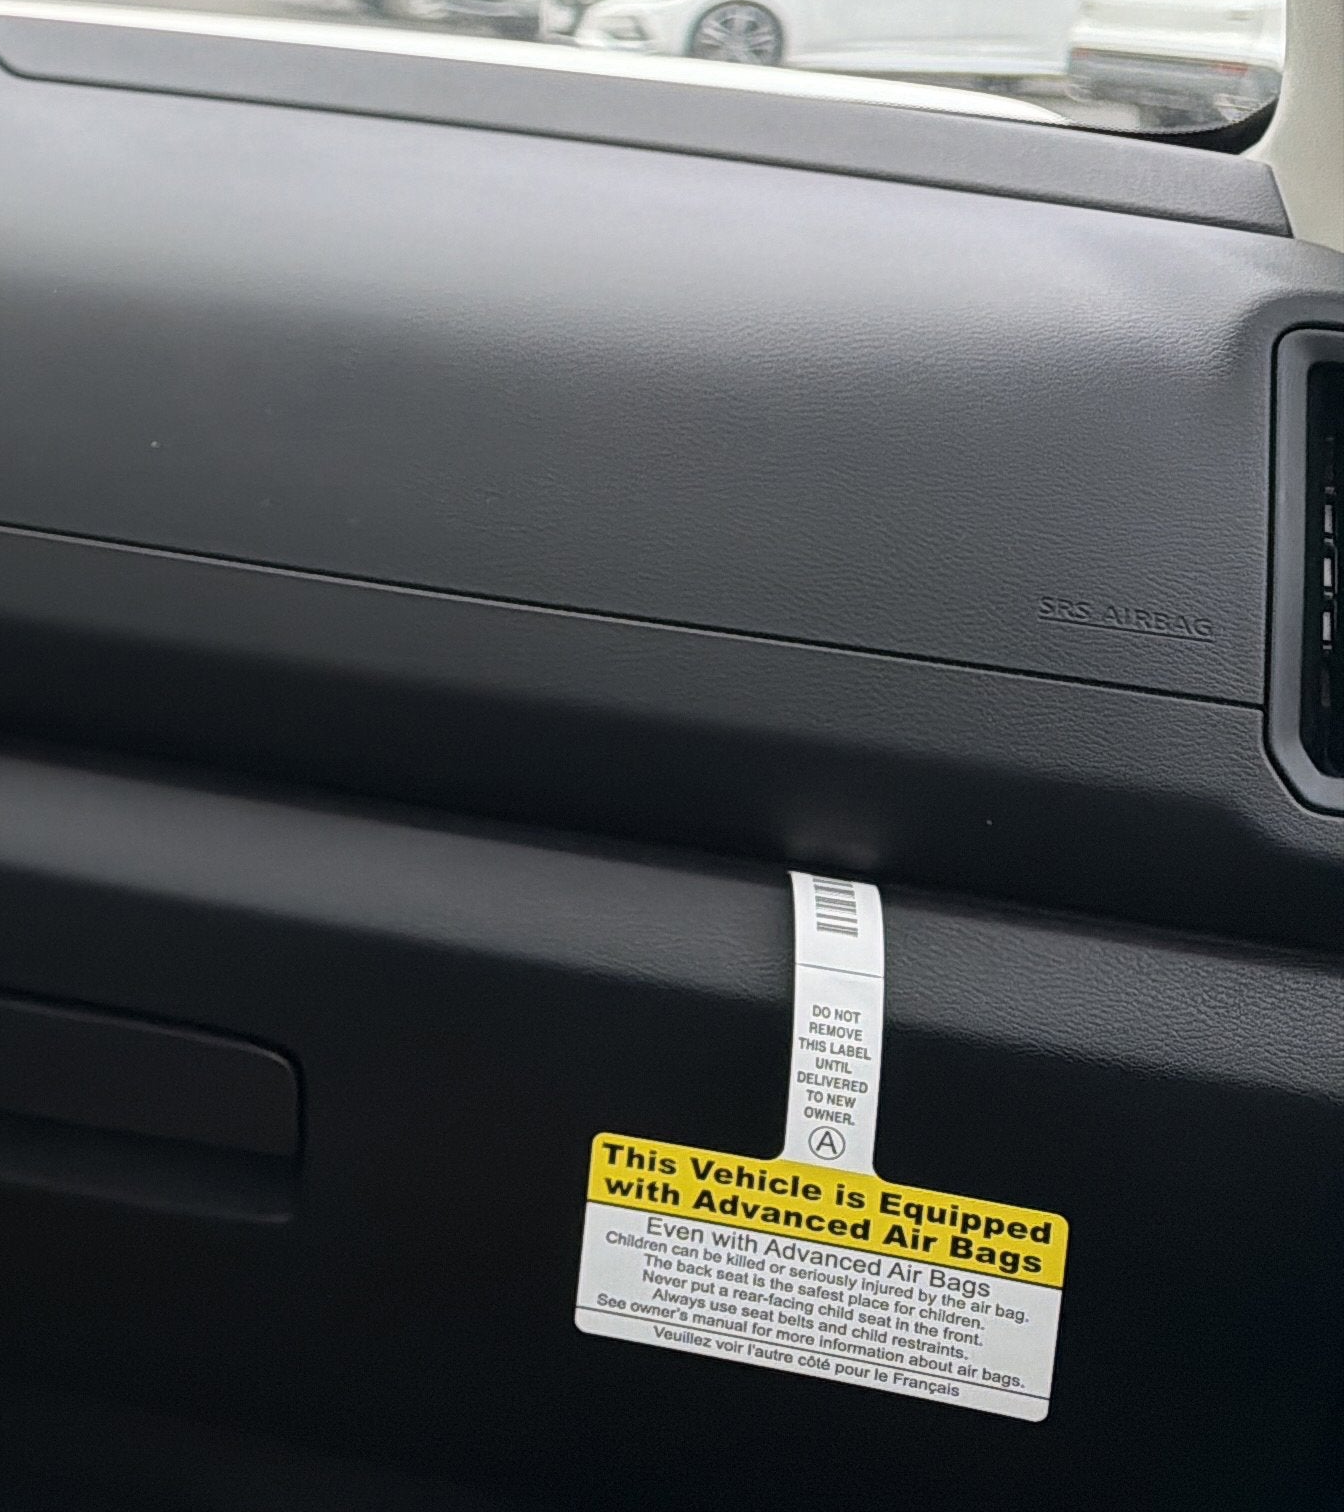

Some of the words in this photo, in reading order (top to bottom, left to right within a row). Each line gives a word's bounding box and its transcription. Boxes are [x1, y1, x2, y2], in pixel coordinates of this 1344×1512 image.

[1038, 596, 1091, 623] SRS
[1101, 603, 1214, 638] AIRBAG
[798, 1036, 826, 1052] THIS
[829, 1042, 871, 1060] LABEL
[808, 1021, 862, 1041] REMOVE
[812, 1004, 831, 1019] DO
[834, 1008, 861, 1024] NOT
[796, 1070, 868, 1093] DELIVERED
[806, 1088, 823, 1103] TO
[826, 1092, 856, 1108] NEW
[815, 1056, 852, 1074] UNTIL
[803, 1106, 855, 1126] OWNER.
[602, 1142, 676, 1174] This
[690, 1157, 821, 1200] Vehicle
[835, 1183, 865, 1208] is
[879, 1191, 1051, 1244] Equipped
[605, 1177, 679, 1205] with
[692, 1189, 870, 1240] Advanced
[882, 1224, 938, 1252] Air
[949, 1235, 1041, 1274] Bags
[605, 1230, 667, 1254] Children
[671, 1245, 698, 1259] can
[702, 1248, 722, 1264] be
[726, 1253, 765, 1272] killed
[769, 1264, 785, 1276] or
[788, 1265, 857, 1292] seriously
[861, 1278, 913, 1303] injured
[917, 1289, 937, 1307] by
[941, 1293, 966, 1311] the
[970, 1299, 991, 1315] air
[994, 1303, 1029, 1325] bag.
[643, 1253, 672, 1270] The
[676, 1259, 712, 1278] back
[716, 1269, 748, 1285] seat
[752, 1273, 765, 1287] is
[770, 1277, 793, 1292] the
[797, 1284, 844, 1302] safest
[847, 1293, 889, 1311] place
[894, 1300, 916, 1316] for
[918, 1307, 984, 1330] children.
[646, 1216, 703, 1243] Even
[711, 1231, 757, 1253] with
[763, 1238, 881, 1276] Advanced
[886, 1262, 922, 1283] Air
[929, 1268, 990, 1298] Bags
[596, 1292, 626, 1309] See
[630, 1301, 688, 1321] owner's
[692, 1313, 747, 1332] manual
[751, 1322, 772, 1337] for
[775, 1329, 814, 1345] more
[819, 1335, 904, 1363] information
[908, 1354, 952, 1373] about
[956, 1364, 978, 1378] air
[981, 1367, 1025, 1388] bags.
[642, 1269, 687, 1289] Never
[690, 1281, 715, 1294] put
[718, 1286, 728, 1297] a
[732, 1288, 814, 1315] rear-facing
[818, 1304, 854, 1320] child
[858, 1312, 891, 1328] seat
[895, 1317, 909, 1332] in
[914, 1321, 938, 1337] the
[943, 1326, 983, 1346] front.
[652, 1287, 706, 1309] Always
[709, 1300, 737, 1314] use
[741, 1306, 774, 1322] seat
[777, 1311, 814, 1329] belts
[818, 1321, 847, 1335] and
[851, 1326, 887, 1343] child
[891, 1335, 968, 1360] restraints.
[653, 1325, 712, 1348] Veuillez
[715, 1340, 744, 1353] voir
[747, 1343, 793, 1363] l'autre
[797, 1355, 830, 1370] côté
[834, 1363, 870, 1378] pour
[873, 1368, 888, 1382] le
[893, 1372, 959, 1396] Français
